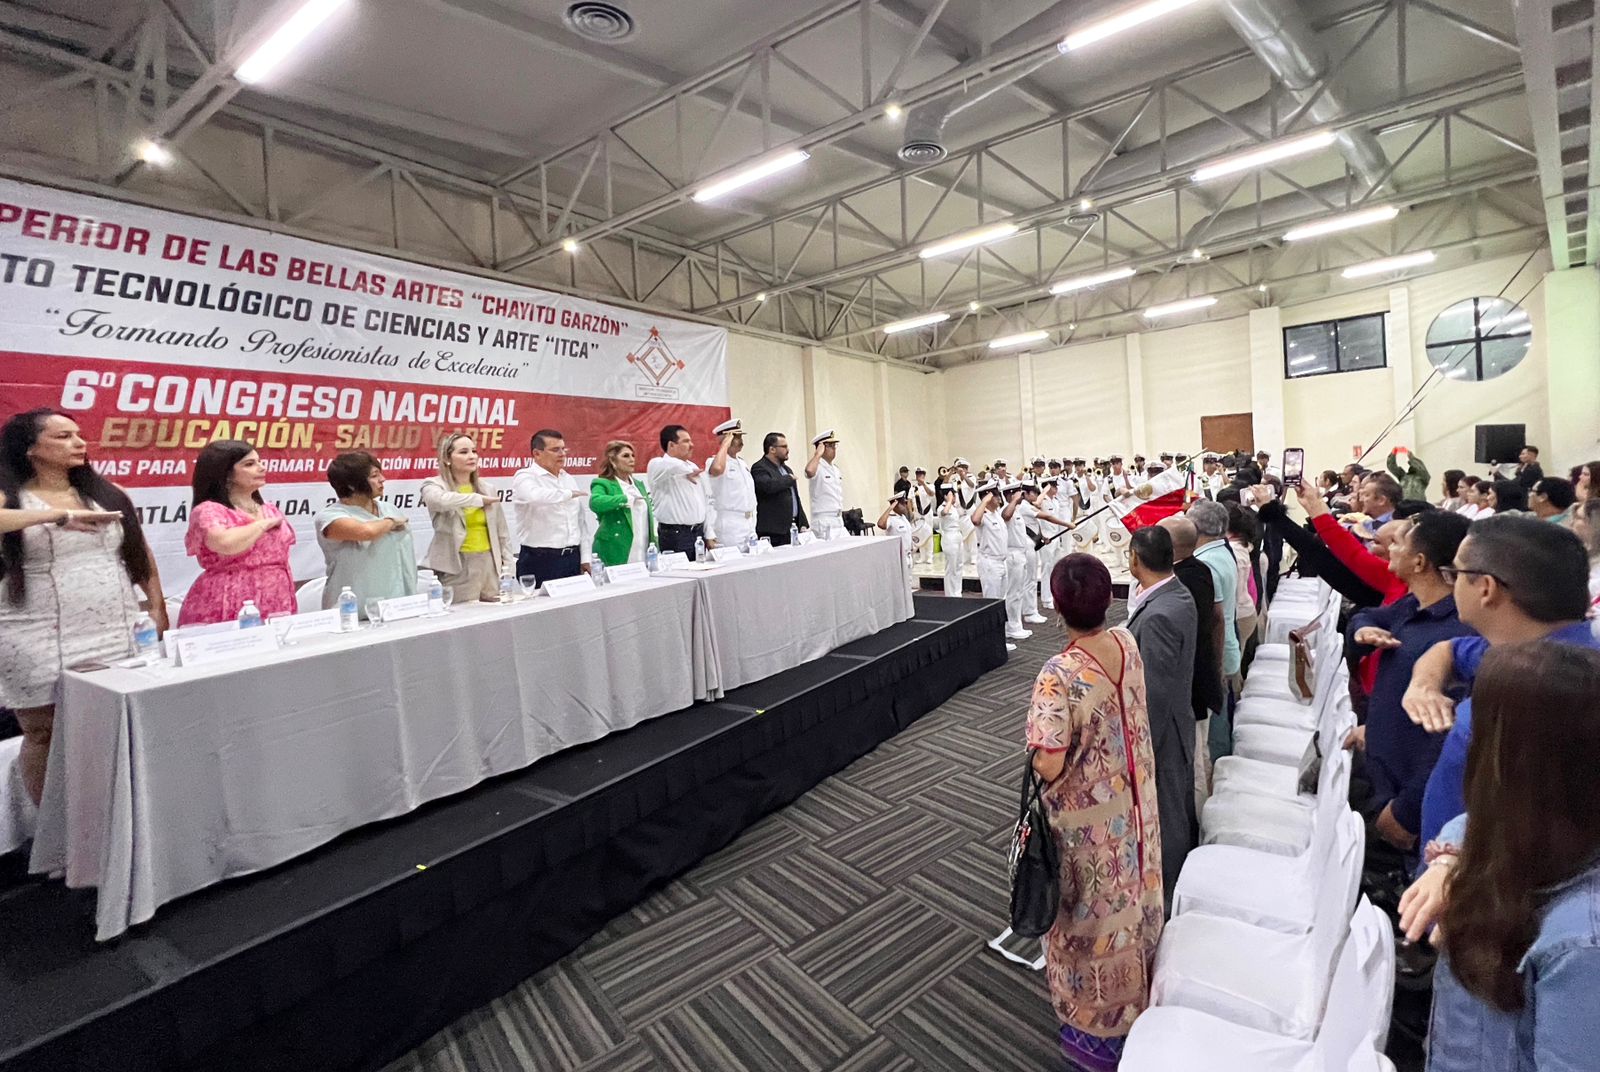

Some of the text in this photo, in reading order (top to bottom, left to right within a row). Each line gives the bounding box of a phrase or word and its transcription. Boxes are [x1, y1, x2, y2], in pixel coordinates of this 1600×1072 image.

[162, 234, 211, 266] DE
[218, 245, 279, 277] LAS
[287, 257, 386, 296] BELLAS
[392, 279, 464, 309] ARTES
[72, 264, 312, 322] TECNOLÓGICO
[321, 302, 358, 328] DE
[364, 309, 471, 344] CIENCIAS
[478, 325, 489, 346] Y
[492, 329, 540, 353] ARTE
[240, 329, 399, 367] Profesionistas
[408, 350, 431, 370] de
[370, 390, 519, 427] NACIONAL
[334, 424, 422, 450] SALUD
[89, 459, 132, 476] VAS
[137, 459, 187, 476] PARA
[414, 457, 440, 470] INTE
[477, 457, 499, 469] ACIA
[501, 457, 522, 469] UNA
